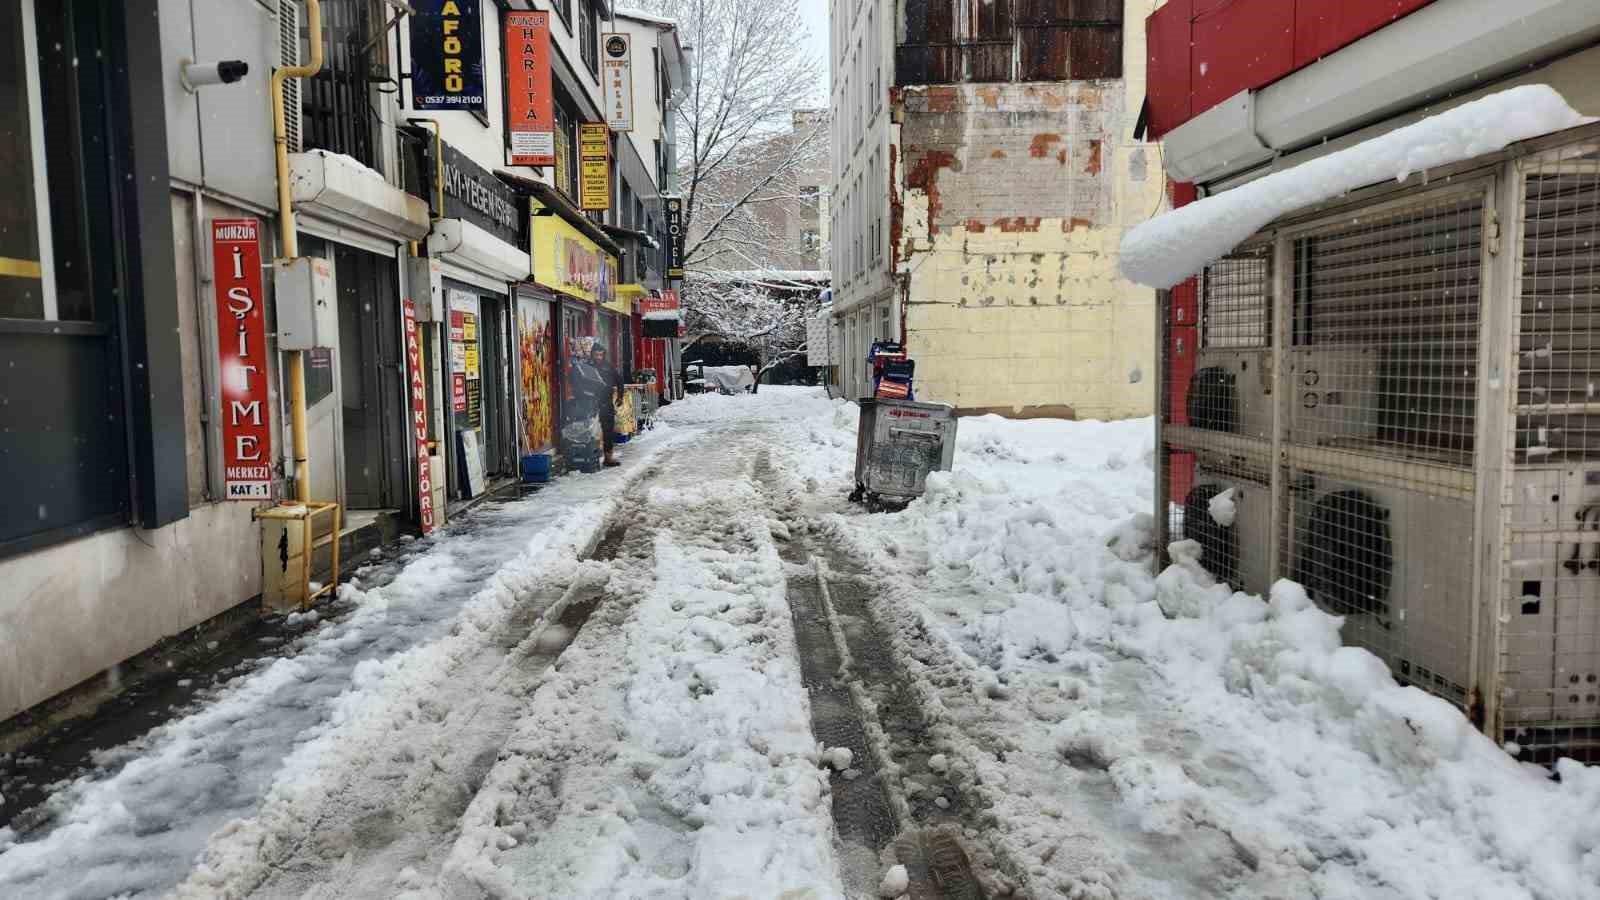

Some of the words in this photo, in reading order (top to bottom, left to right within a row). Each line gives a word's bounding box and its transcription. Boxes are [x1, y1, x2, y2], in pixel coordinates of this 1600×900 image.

[425, 96, 445, 104] 0537
[446, 96, 461, 104] 394
[462, 96, 482, 104] 2100
[215, 225, 256, 240] MUNZUR
[669, 213, 679, 268] HOTEL
[228, 246, 261, 461] İŞİTME
[407, 320, 423, 400] BAYAN
[226, 461, 268, 479] MERKEZİ
[230, 484, 252, 495] KAT
